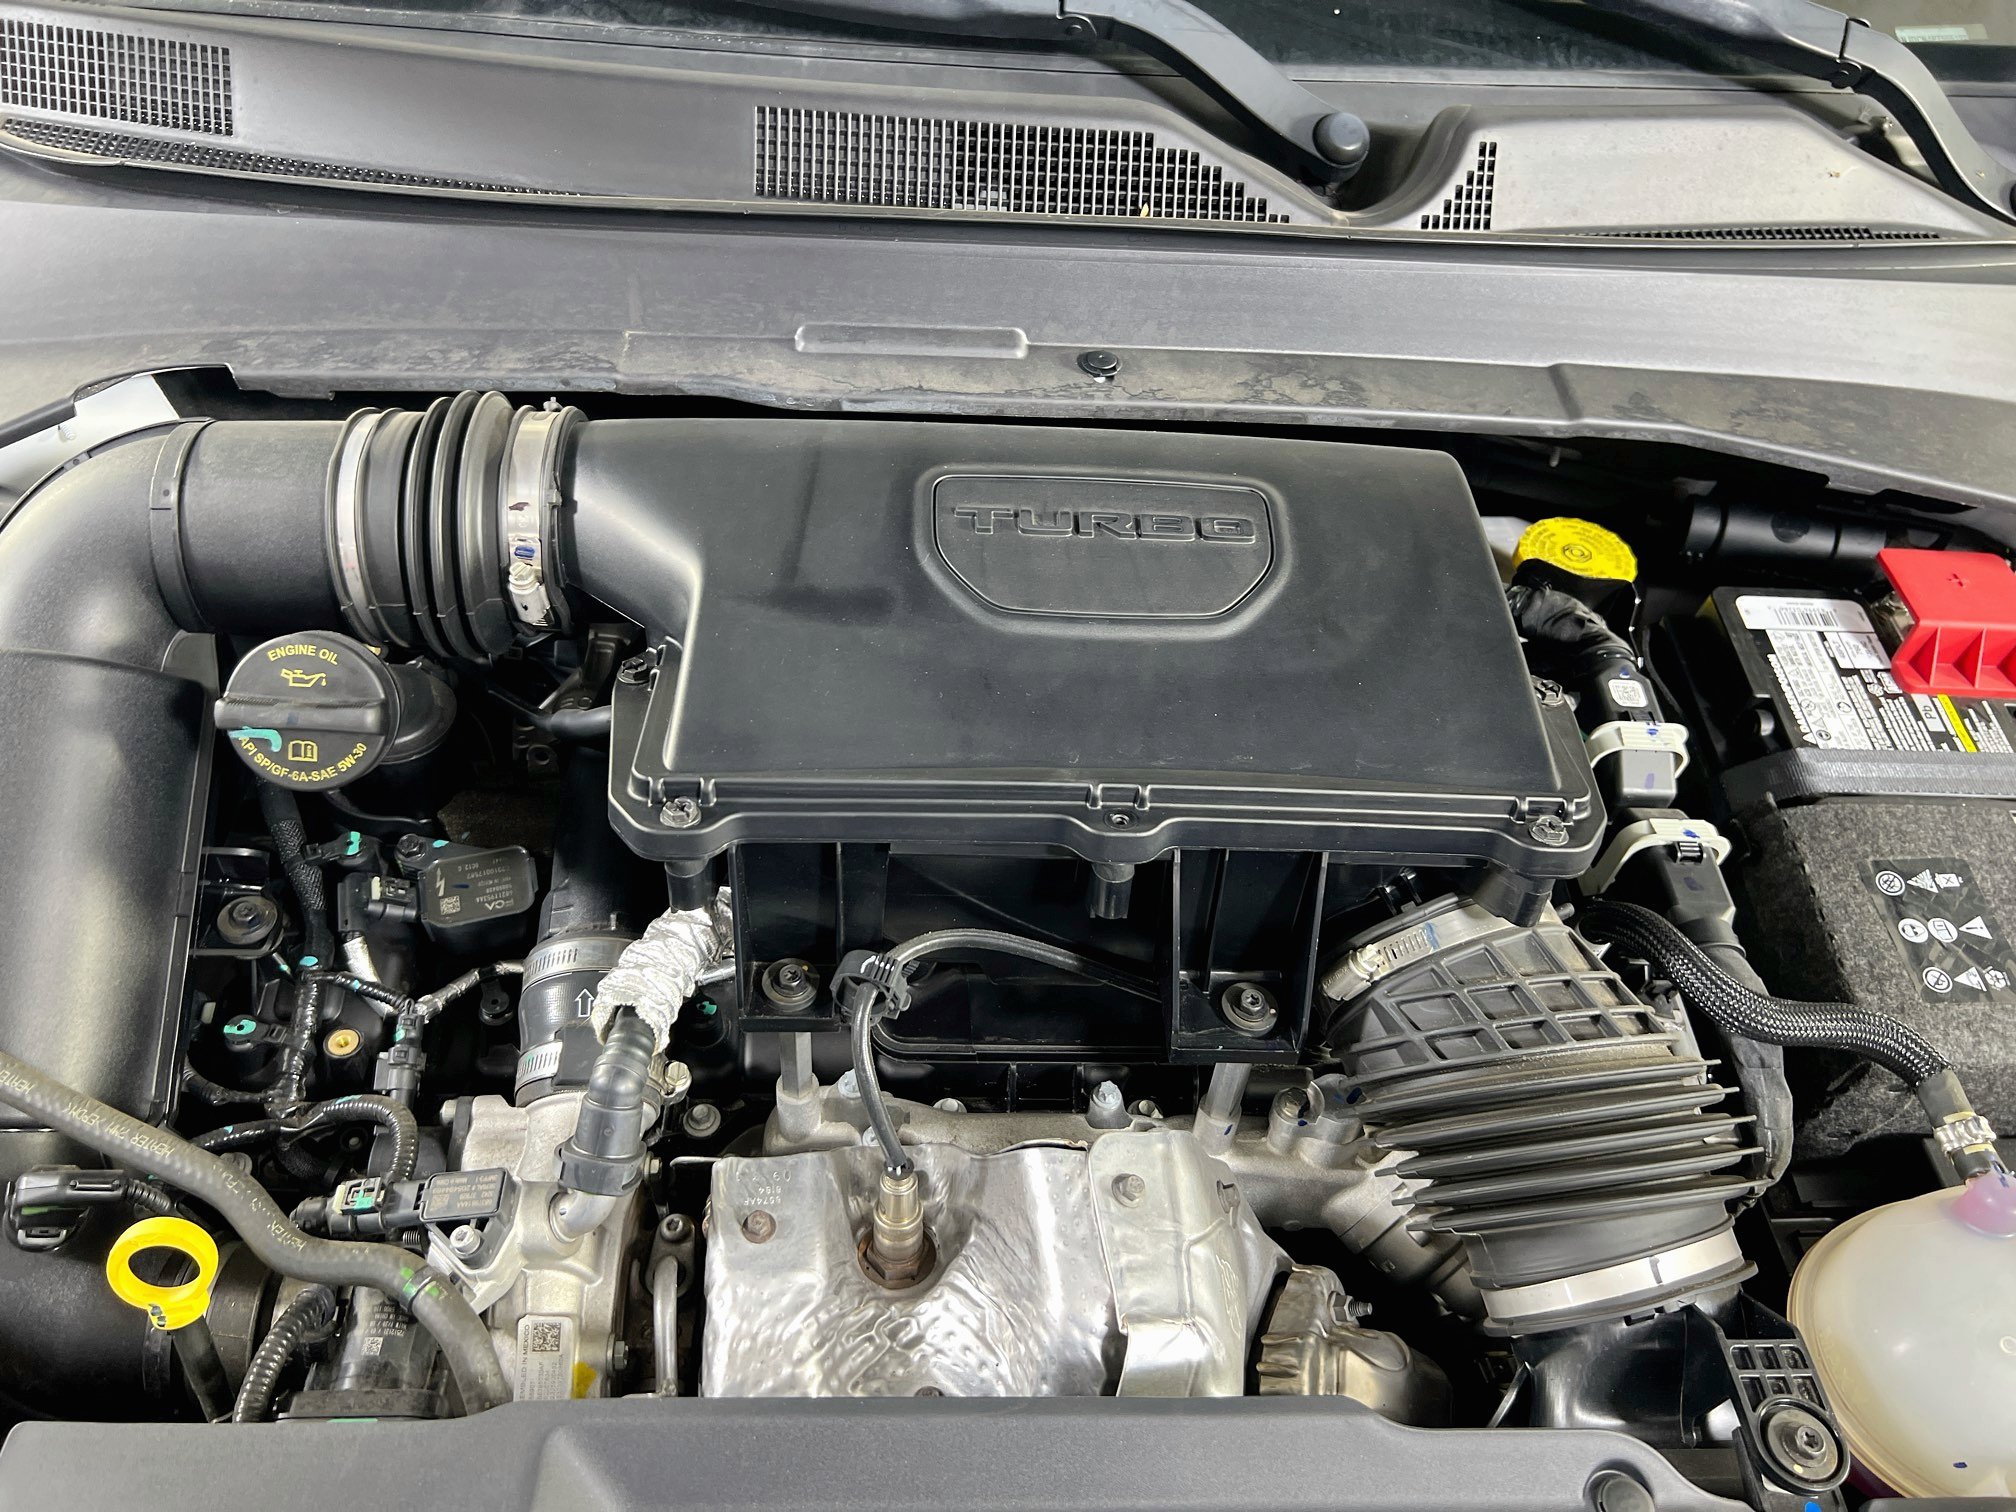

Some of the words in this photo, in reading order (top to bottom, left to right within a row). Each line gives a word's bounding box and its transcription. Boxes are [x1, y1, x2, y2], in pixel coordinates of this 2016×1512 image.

[953, 505, 1256, 543] TURBO
[267, 644, 317, 661] ENGINE
[318, 648, 339, 665] OIL
[1921, 704, 1937, 720] Pb
[238, 736, 257, 755] API
[253, 752, 337, 782] SP/GF-6A-SAE
[337, 742, 368, 773] 5W-30
[484, 898, 514, 911] FCA
[0, 1069, 37, 1096] HEATE
[130, 1132, 175, 1159] HEATER
[522, 1324, 531, 1356] MEXICO
[521, 1357, 529, 1365] IN
